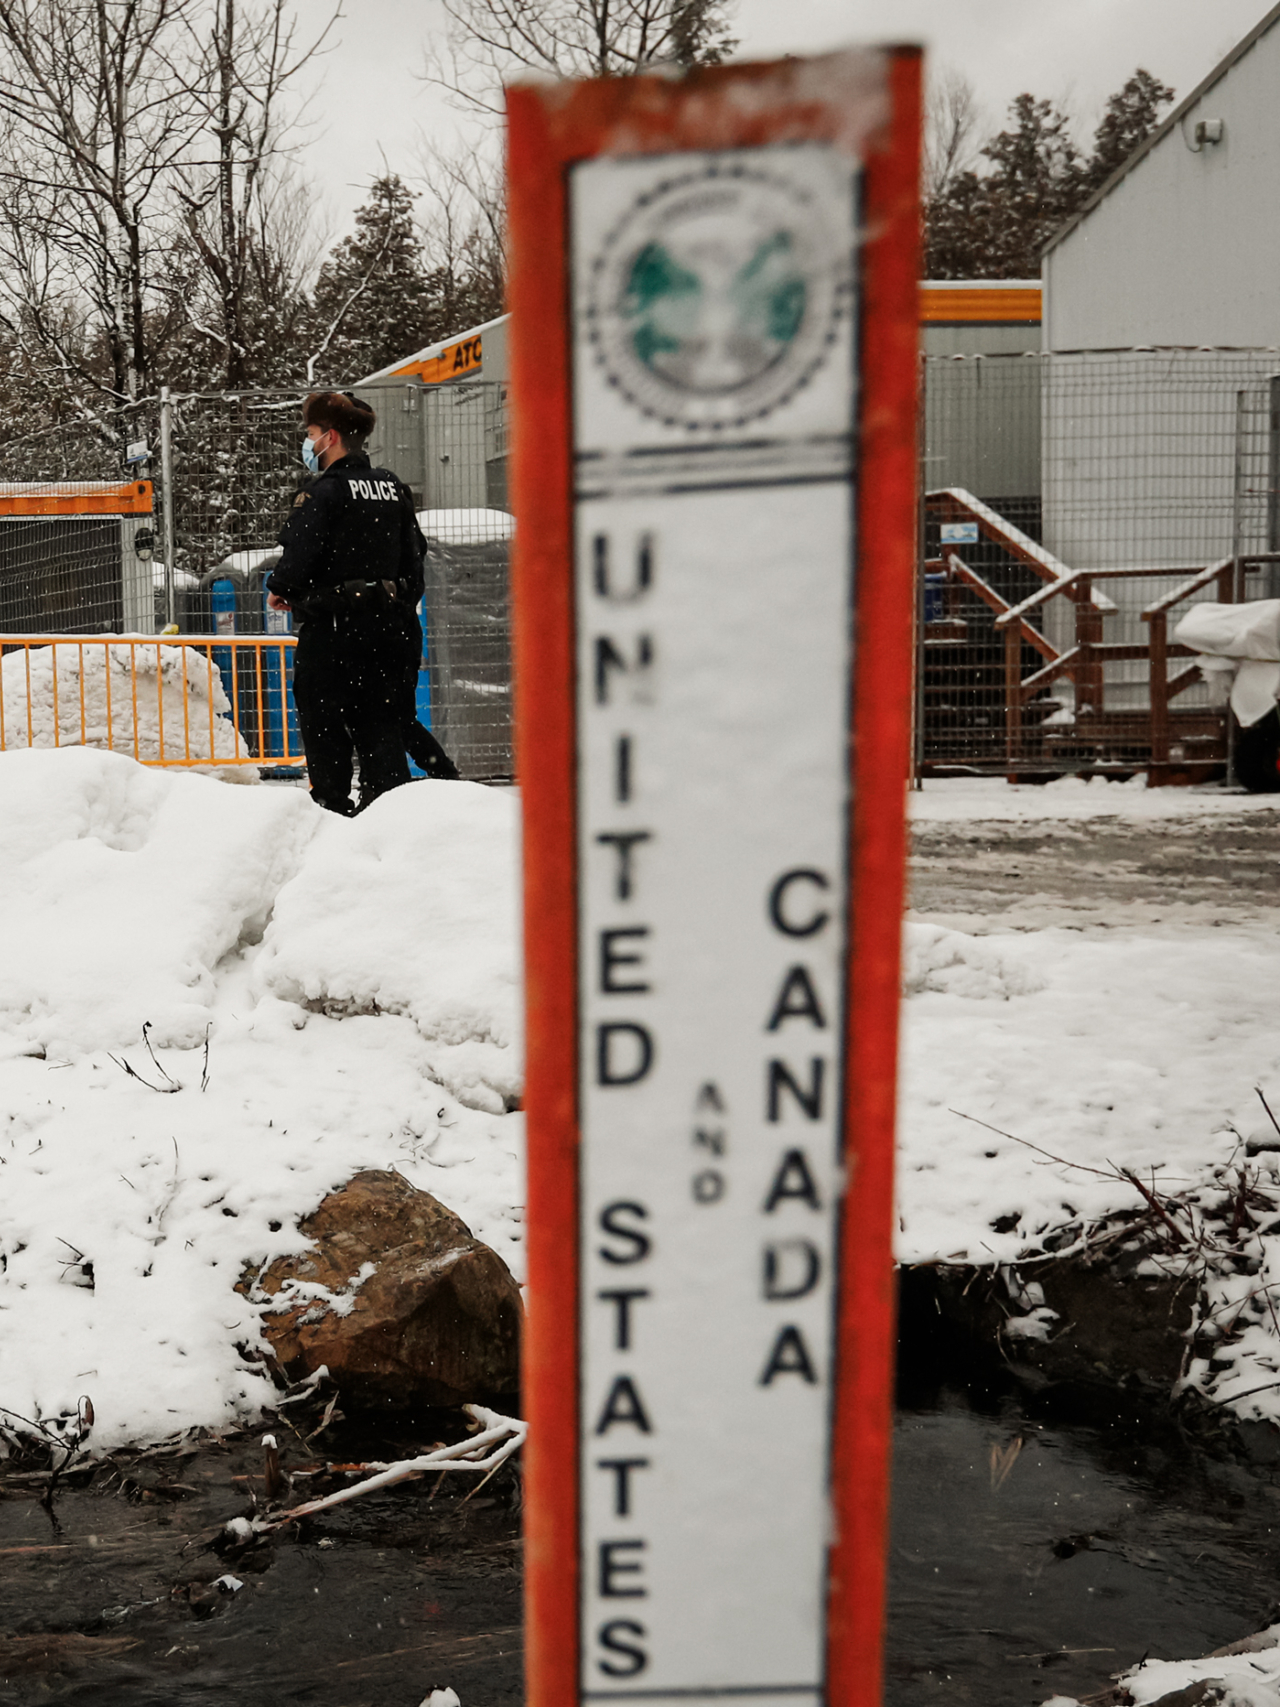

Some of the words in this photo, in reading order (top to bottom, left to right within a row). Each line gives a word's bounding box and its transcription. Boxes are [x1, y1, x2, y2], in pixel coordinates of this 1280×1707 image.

[348, 479, 399, 501] POLICE
[590, 530, 655, 1088] UNITED
[692, 1080, 726, 1204] AND
[757, 867, 831, 1388] CANADA
[594, 1199, 652, 1679] STATES
